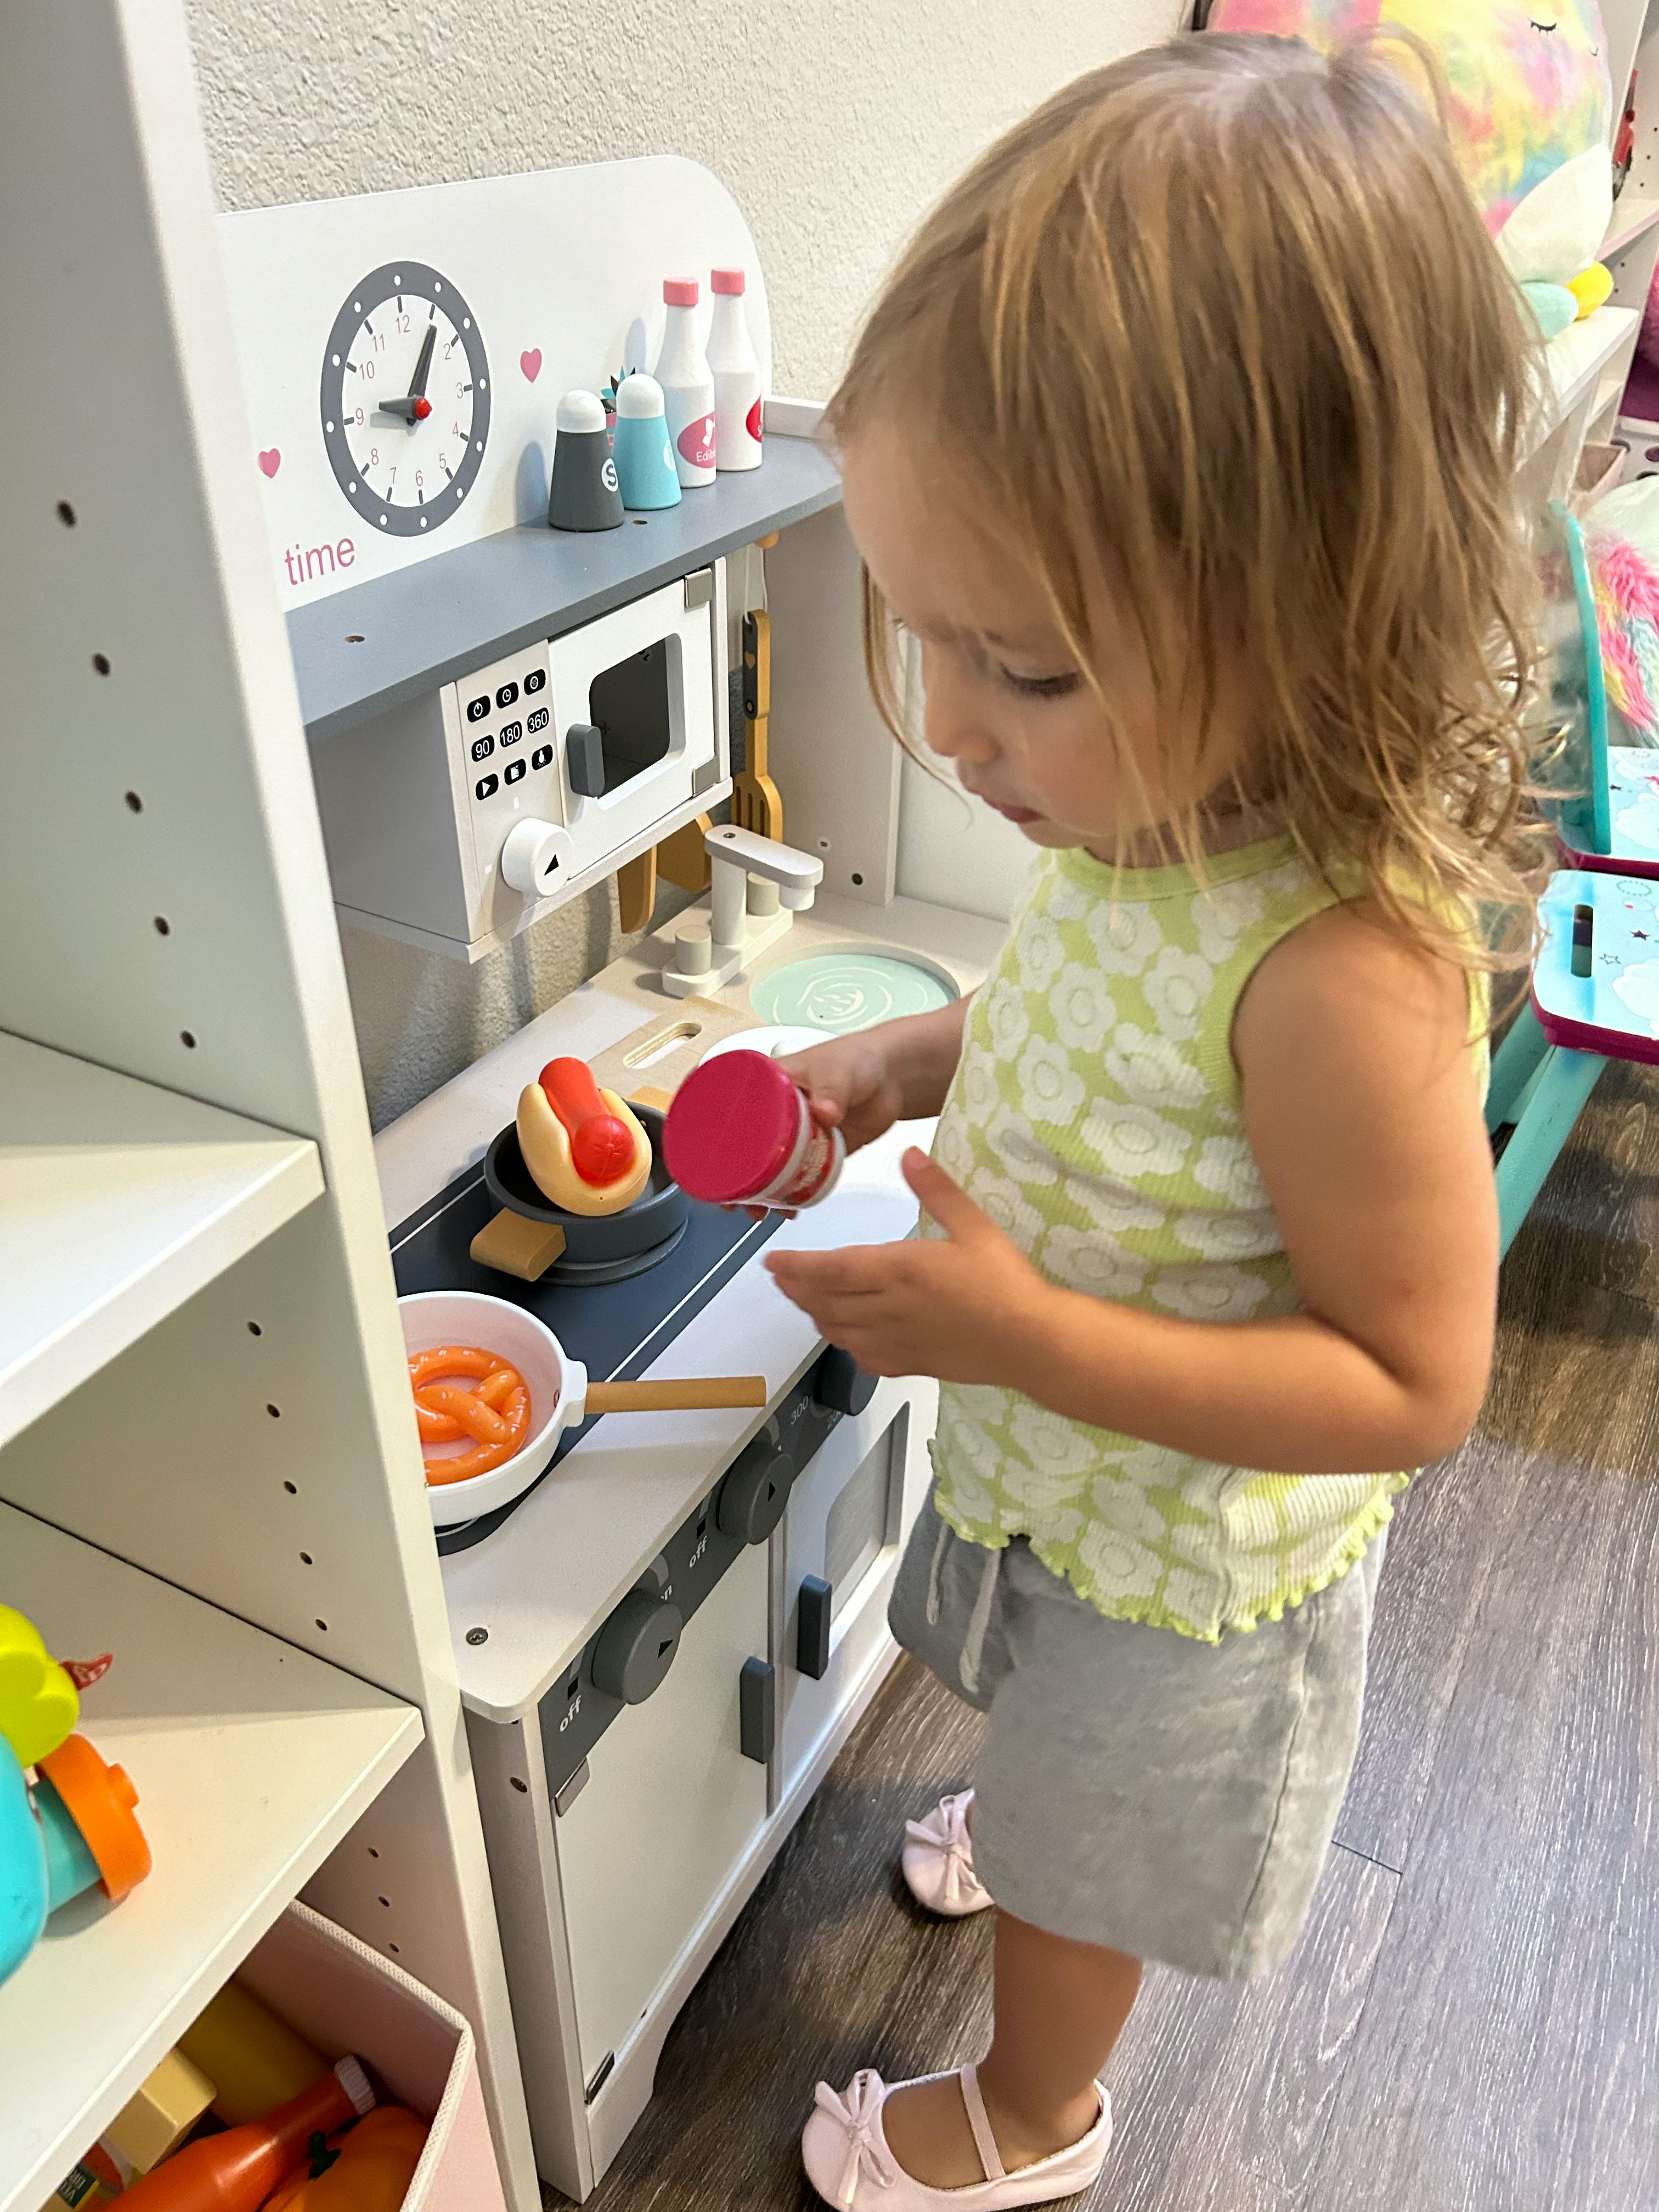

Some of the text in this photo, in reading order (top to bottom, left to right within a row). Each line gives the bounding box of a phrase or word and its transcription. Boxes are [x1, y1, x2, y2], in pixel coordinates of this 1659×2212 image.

[396, 315, 410, 334] 12
[372, 334, 385, 352] 11
[444, 343, 451, 360] 2
[359, 361, 374, 380] 10
[456, 382, 463, 399] 3
[356, 408, 364, 425] 9
[453, 421, 459, 437] 4
[371, 448, 379, 465] 8
[439, 453, 446, 469] 5
[696, 448, 716, 462] Edib
[390, 467, 397, 484] 7
[415, 470, 423, 487] 6
[606, 464, 617, 487] S
[285, 538, 355, 585] time
[528, 711, 548, 732] 360
[500, 725, 520, 745] 180
[476, 740, 490, 758] 90
[791, 1396, 809, 1425] 300
[827, 1410, 842, 1430] 20
[689, 1535, 707, 1568] off
[661, 1585, 672, 1601] n
[560, 1695, 581, 1732] off
